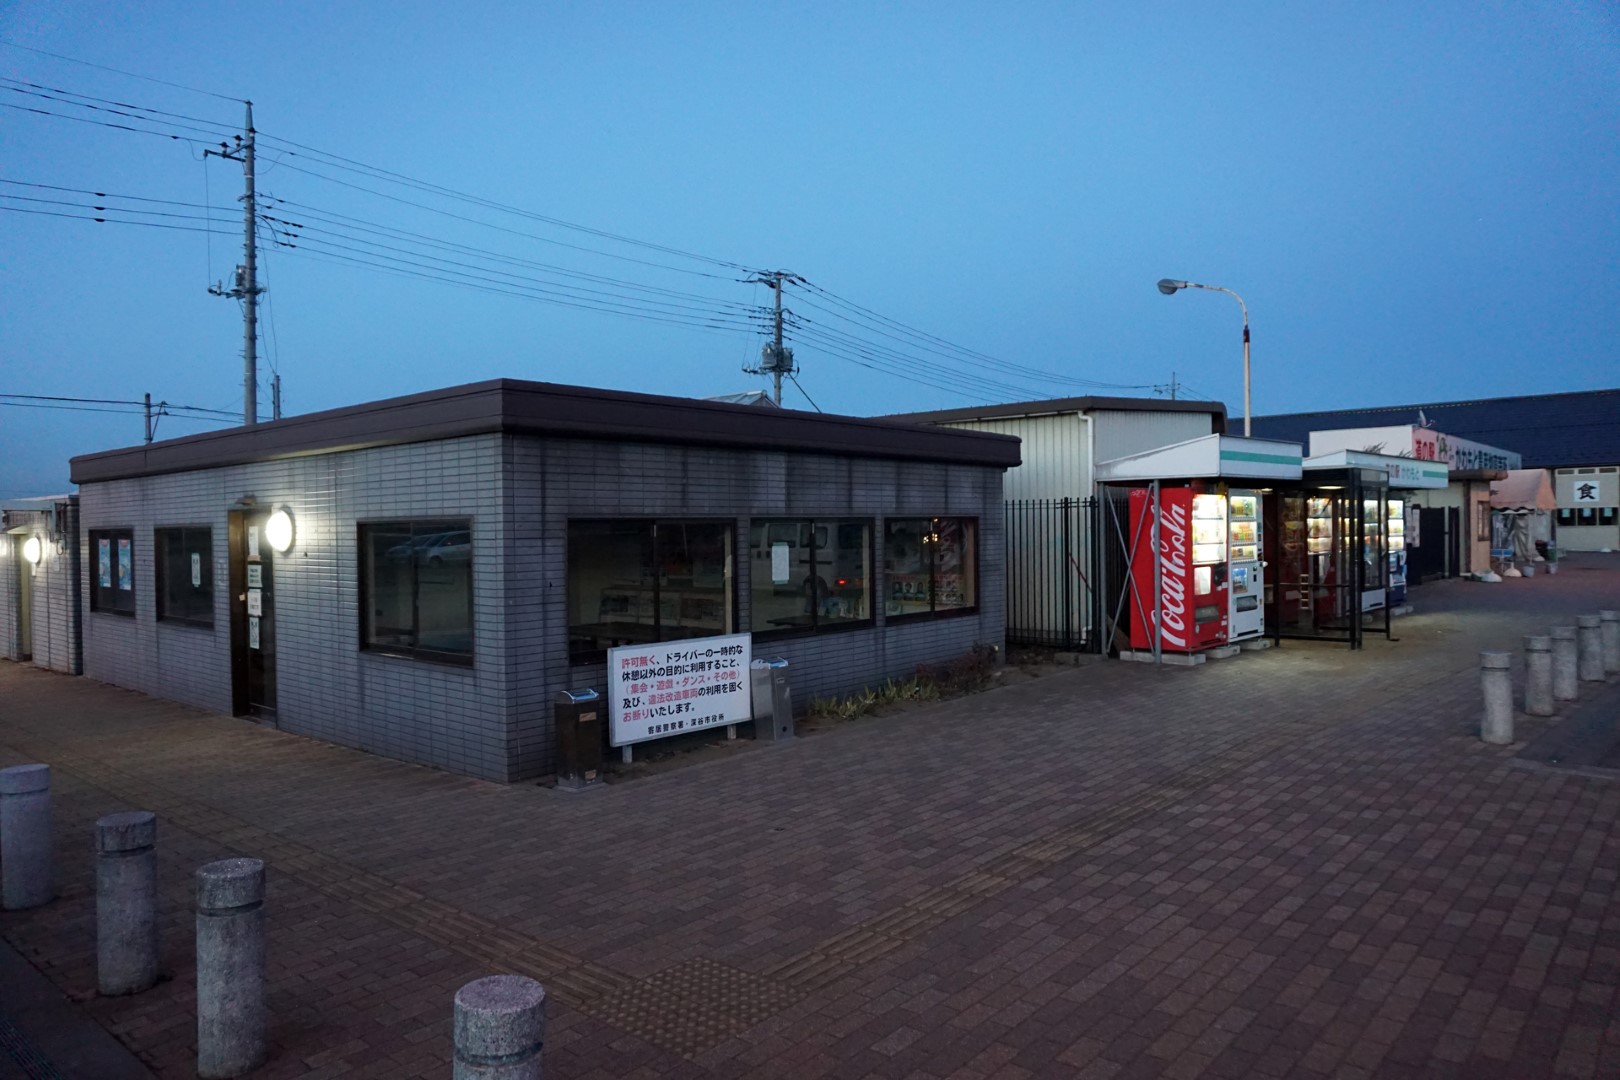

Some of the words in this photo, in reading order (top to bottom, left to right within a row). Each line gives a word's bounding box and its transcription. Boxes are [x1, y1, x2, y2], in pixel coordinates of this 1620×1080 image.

[1576, 482, 1598, 500] 食
[623, 702, 695, 722] お断りいたします。
